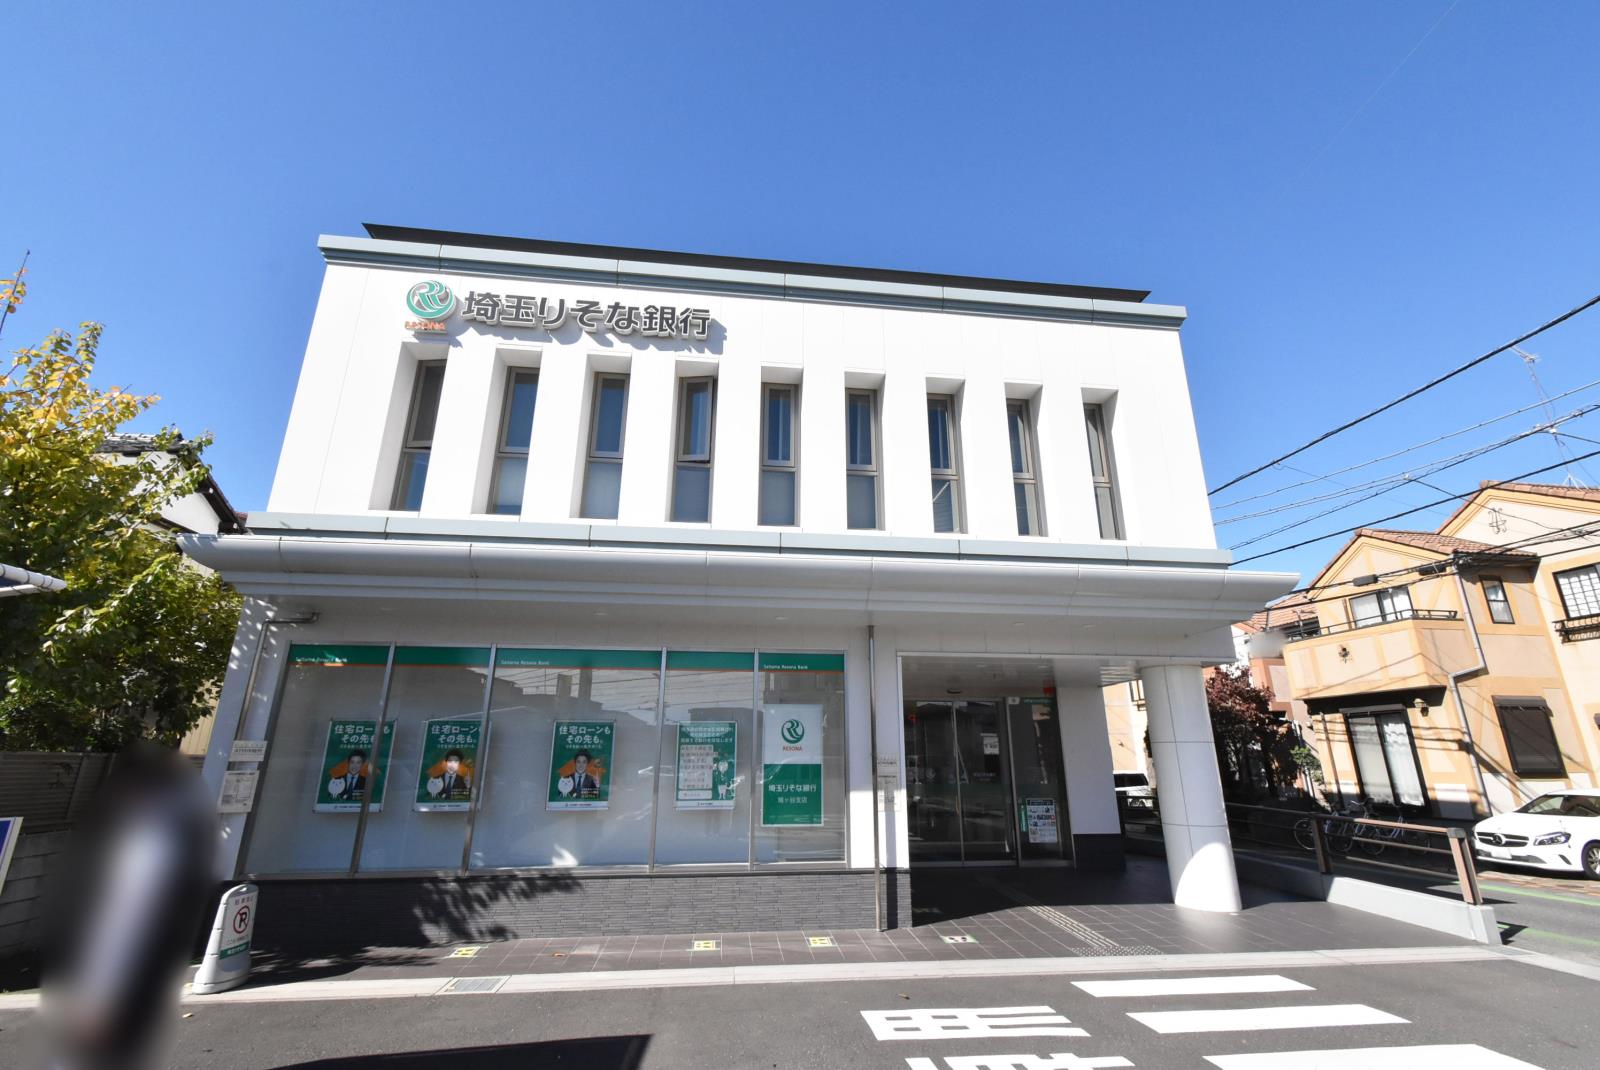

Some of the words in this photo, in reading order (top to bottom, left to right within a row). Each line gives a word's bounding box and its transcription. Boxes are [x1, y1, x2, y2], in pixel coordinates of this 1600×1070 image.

[461, 290, 711, 337] 埼玉りそな銀行
[334, 724, 391, 735] 住宅ローも
[431, 724, 482, 735] 住宅ローン
[559, 725, 611, 735] 住宅ローンも
[768, 783, 818, 793] 埼玉りそな銀行
